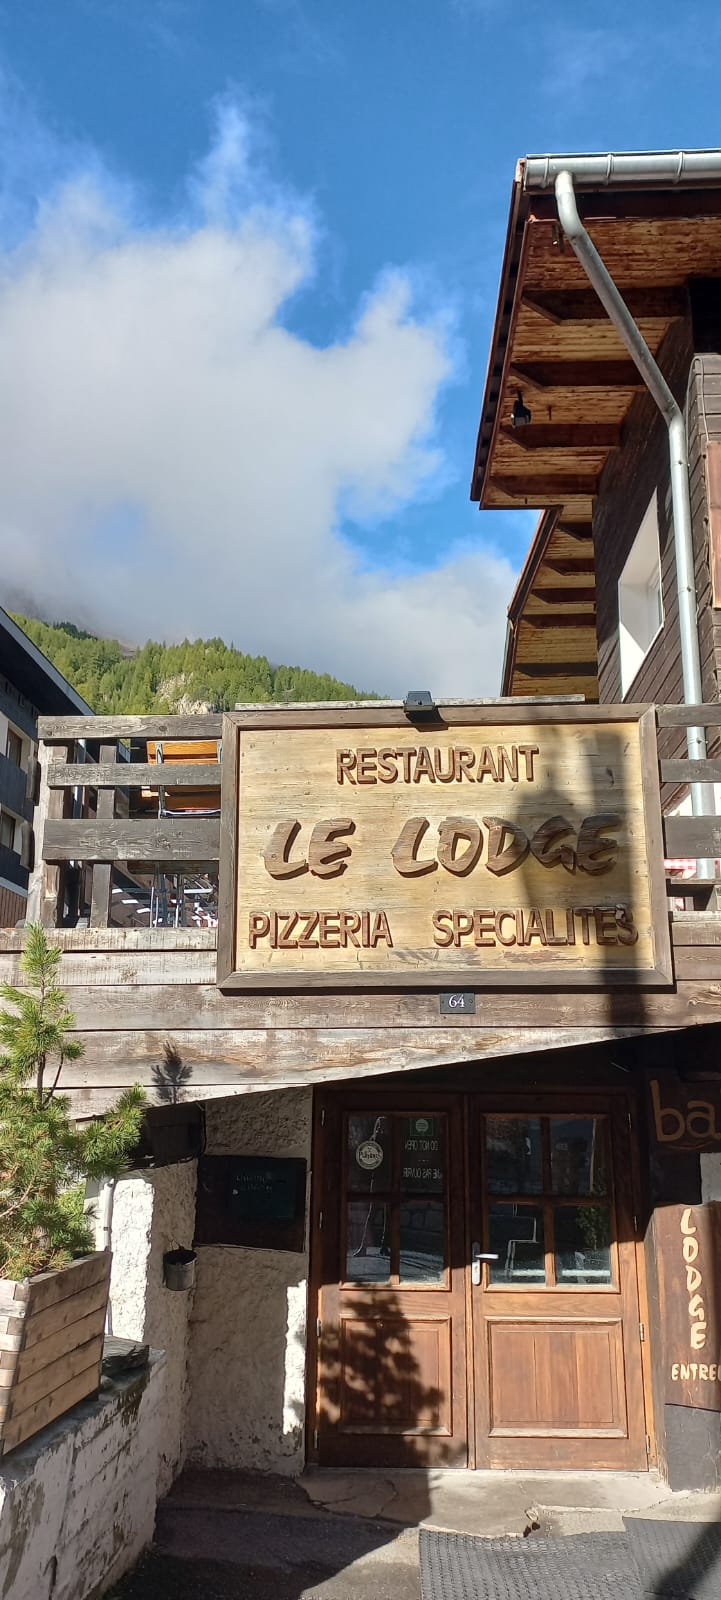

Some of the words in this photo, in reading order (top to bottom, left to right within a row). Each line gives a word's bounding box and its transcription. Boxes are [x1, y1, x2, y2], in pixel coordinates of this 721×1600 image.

[336, 745, 539, 785] RESTAURANT
[263, 818, 356, 880] LE
[391, 814, 623, 878] LODGE
[249, 910, 393, 949] PIZZERIA
[432, 904, 639, 947] SPECIALITES
[448, 994, 465, 1008] 64
[651, 1080, 721, 1142] ba
[680, 1208, 707, 1349] LODGE
